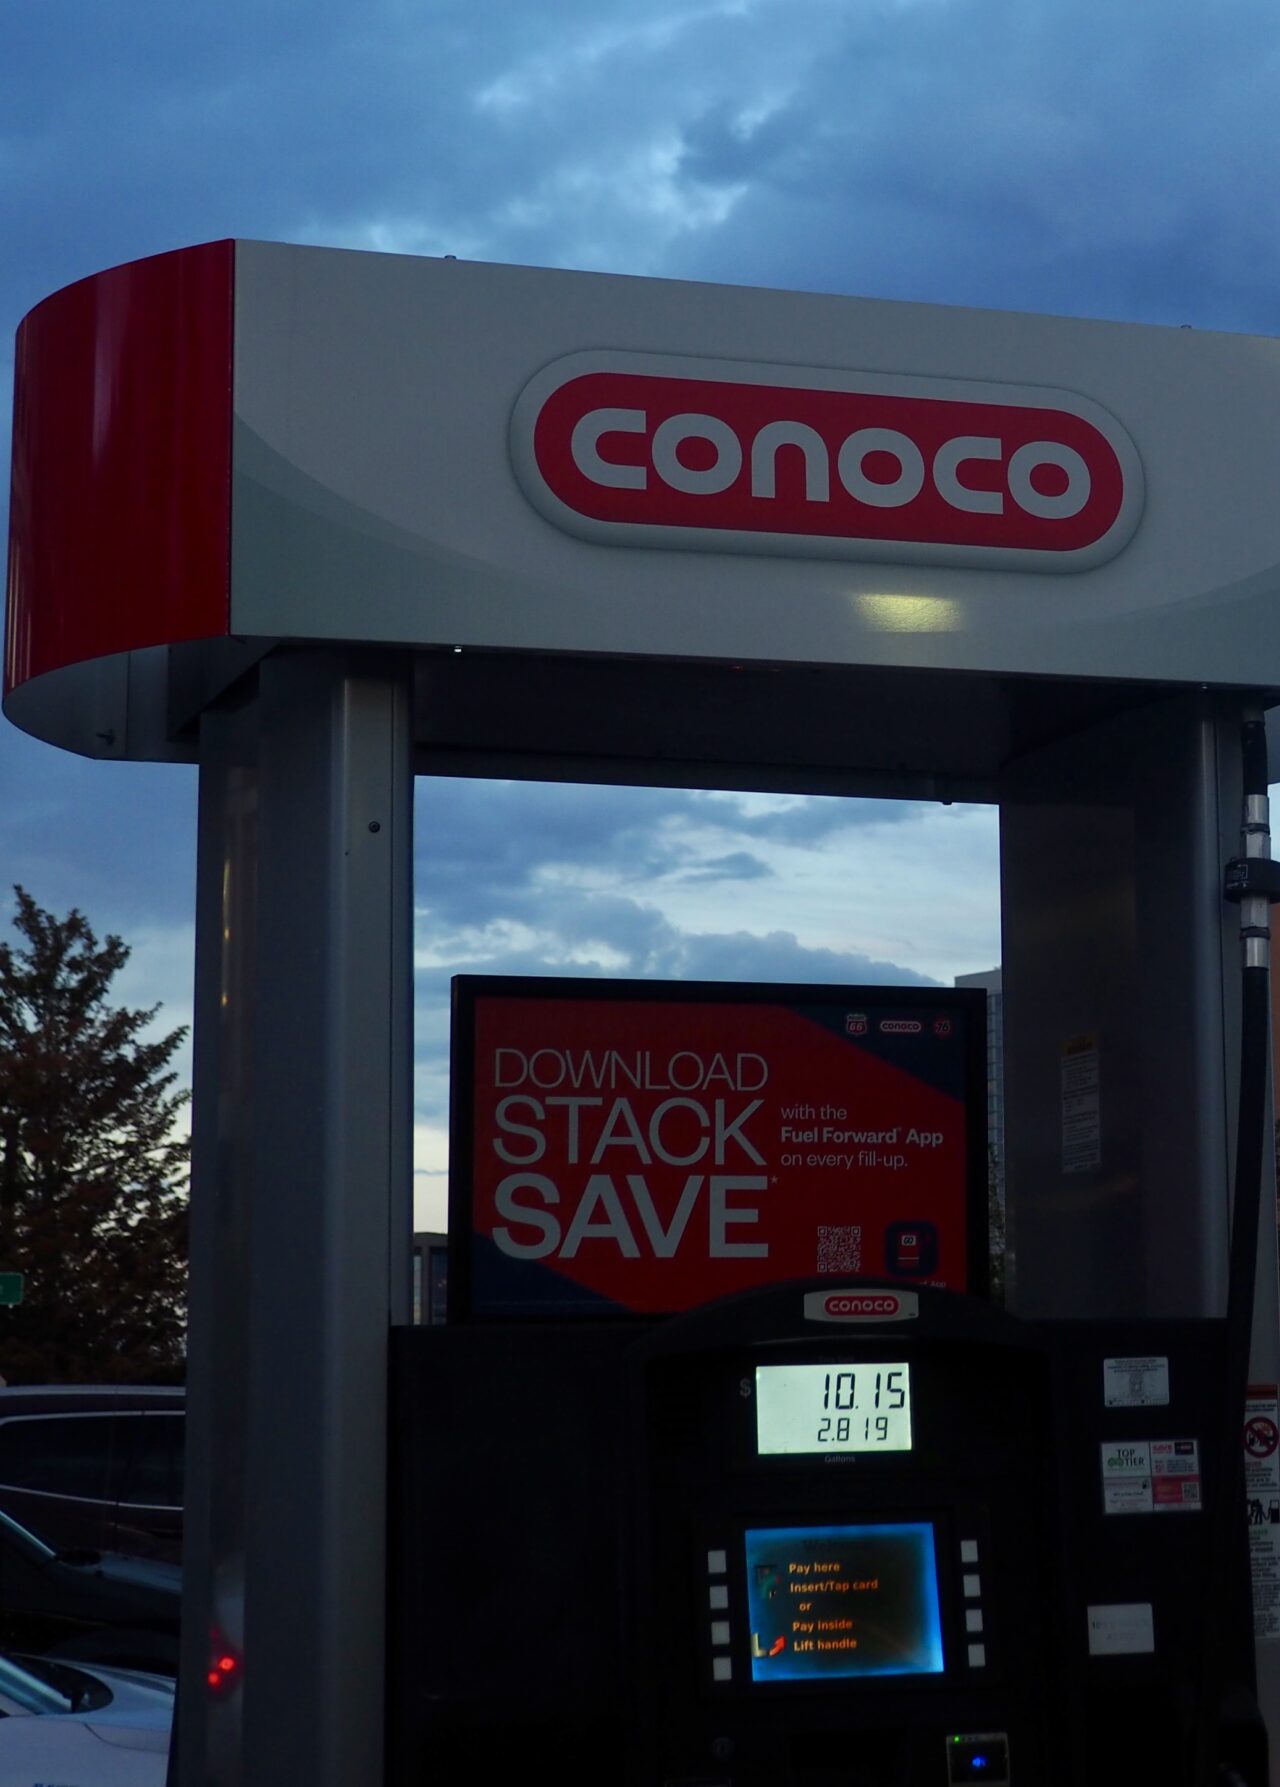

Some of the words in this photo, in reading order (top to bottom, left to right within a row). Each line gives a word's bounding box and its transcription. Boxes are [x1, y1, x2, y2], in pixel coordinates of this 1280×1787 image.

[570, 407, 1091, 519] conoco
[882, 1022, 920, 1031] conoco
[935, 1020, 950, 1033] 76
[494, 1047, 769, 1091] DOWNLOAD
[780, 1104, 816, 1120] with
[820, 1104, 848, 1120] the
[492, 1094, 769, 1167] STACK
[780, 1127, 818, 1143] Fuel
[905, 1128, 944, 1148] App
[780, 1153, 802, 1167] on
[806, 1154, 855, 1170] every
[858, 1150, 908, 1171] fill-up.
[829, 1300, 895, 1312] conoco
[739, 1378, 752, 1399] $
[824, 1371, 904, 1410] 10.15
[817, 1417, 888, 1442] 2.819
[1117, 1448, 1136, 1458] TOP
[1125, 1456, 1145, 1467] TIER
[788, 1562, 811, 1576] Pay
[814, 1562, 840, 1574] here
[789, 1580, 849, 1593] Insert/Tap
[852, 1578, 879, 1591] card
[799, 1602, 812, 1612] or
[792, 1621, 814, 1633] Pay
[793, 1641, 814, 1652] Lift
[817, 1638, 857, 1650] handle
